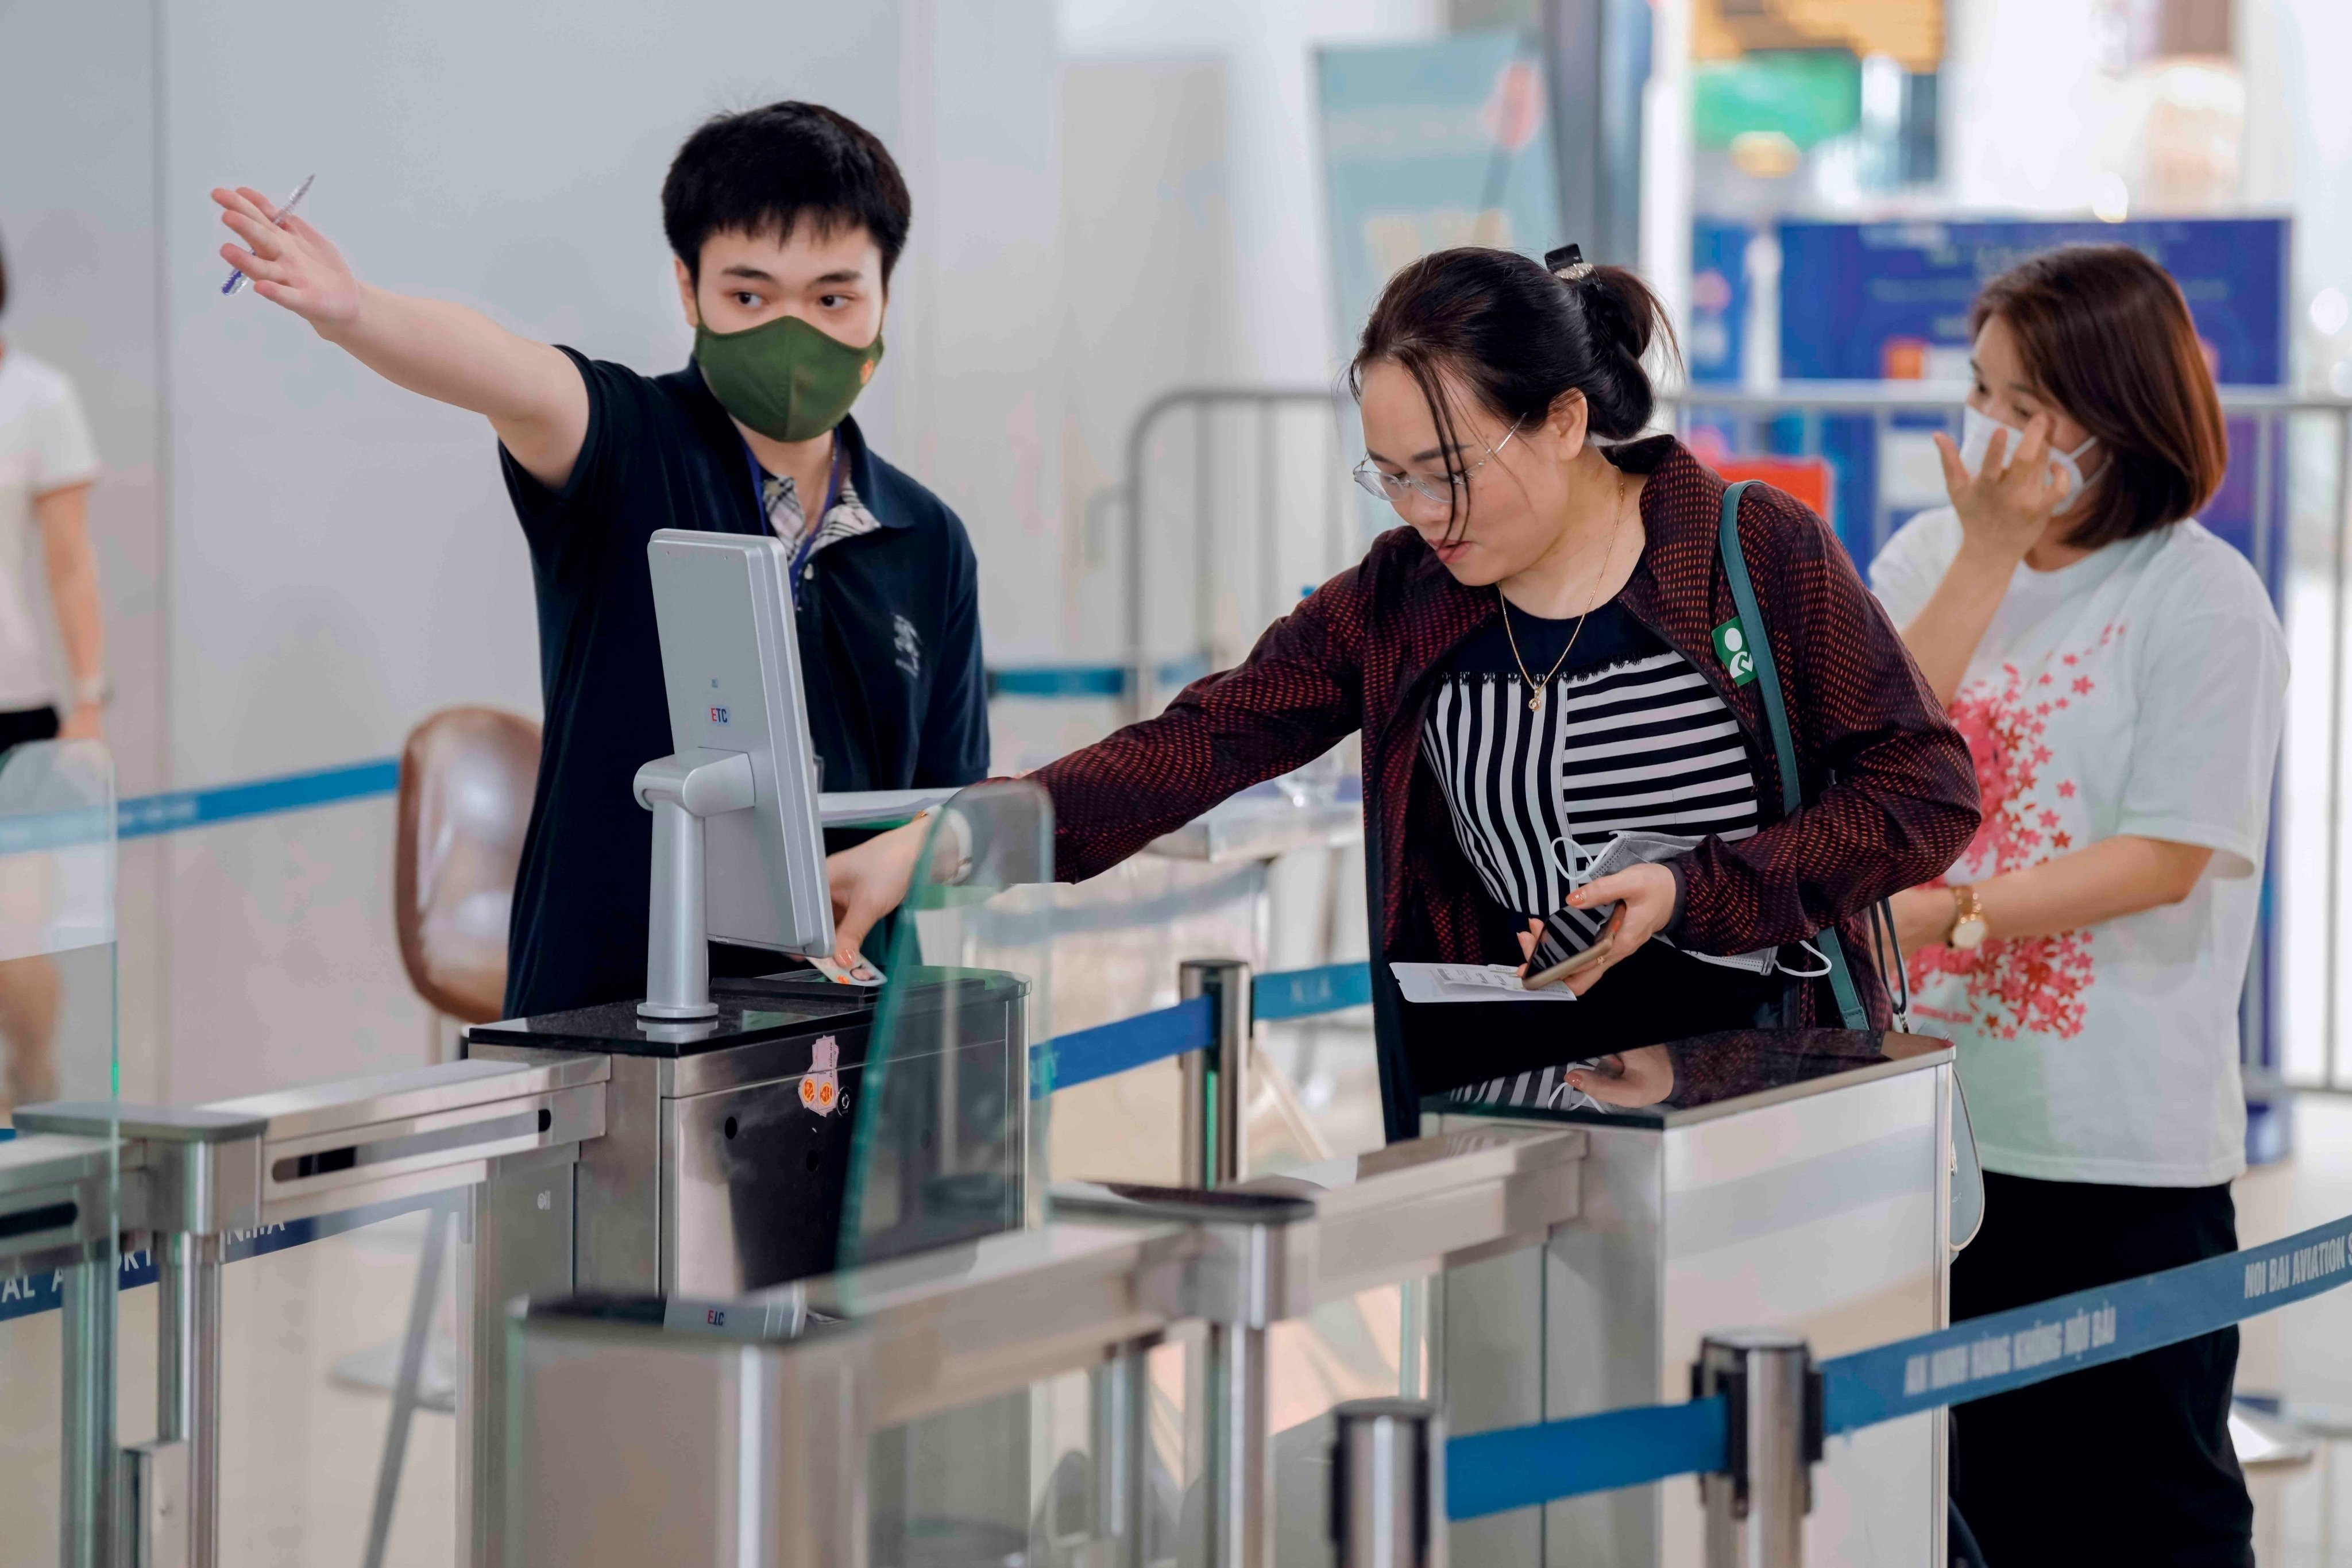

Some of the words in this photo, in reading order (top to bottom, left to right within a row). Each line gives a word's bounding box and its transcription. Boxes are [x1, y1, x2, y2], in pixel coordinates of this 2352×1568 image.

[710, 707, 728, 723] ETC
[2244, 1260, 2266, 1299] NOI
[2269, 1254, 2289, 1293] BAI
[2292, 1235, 2345, 1286] AVIATION
